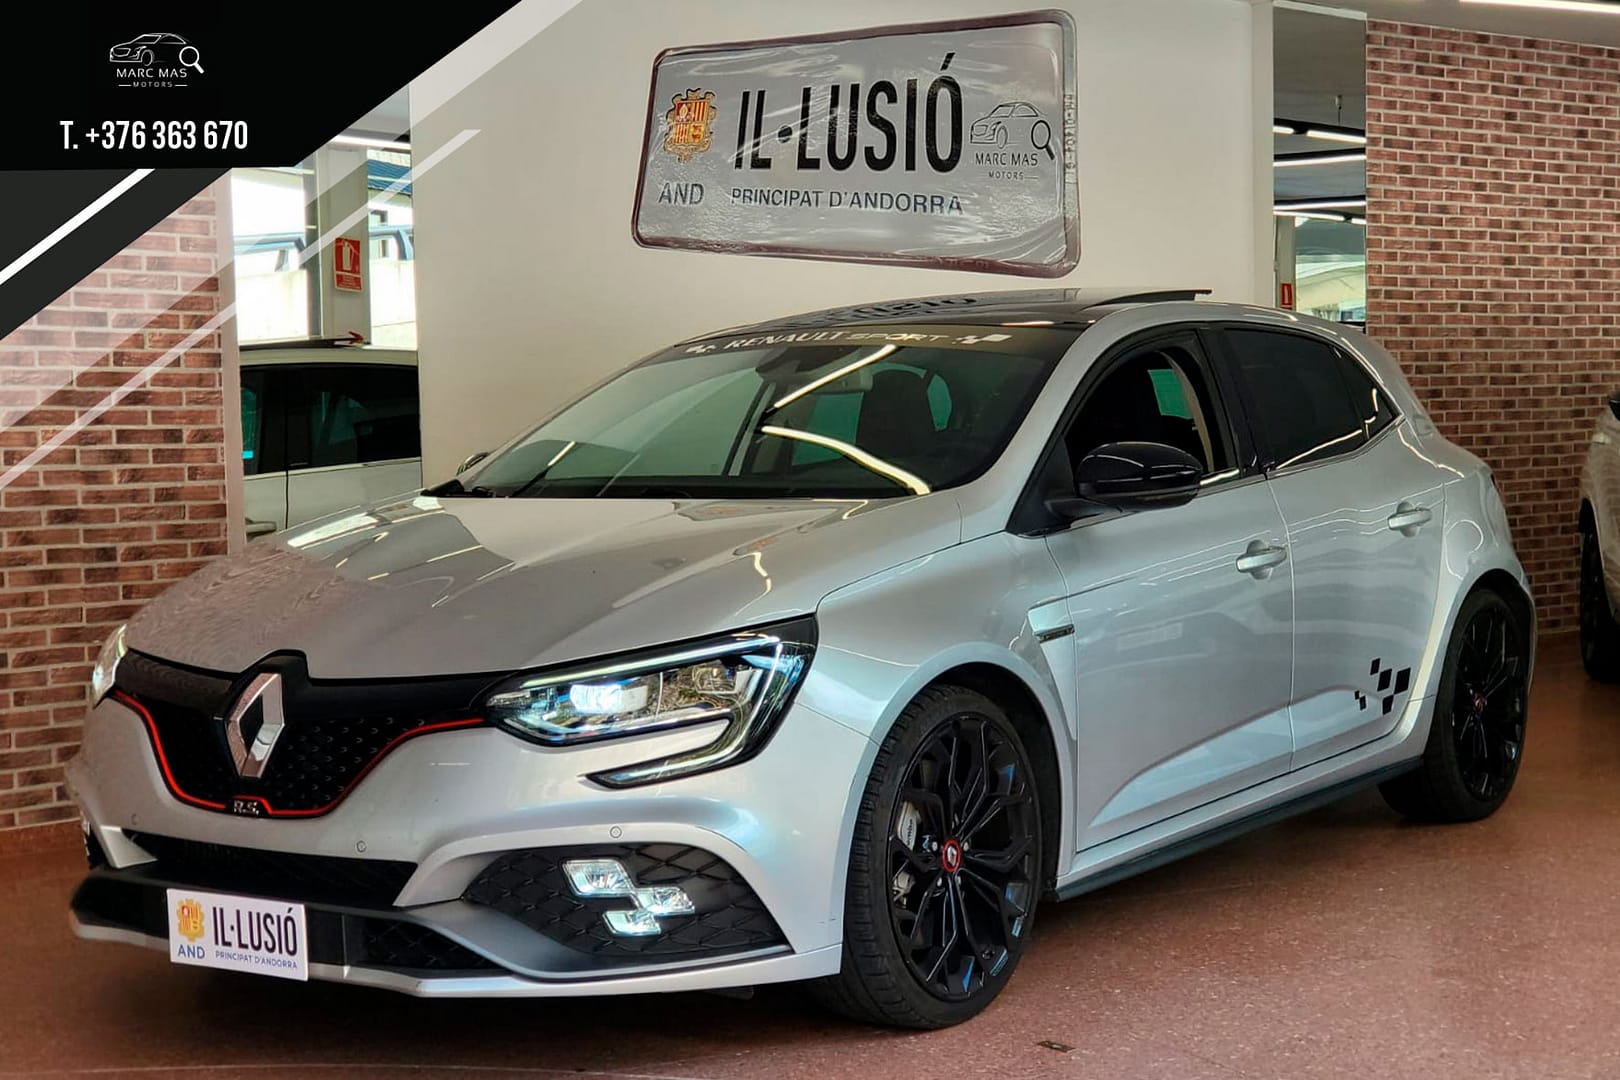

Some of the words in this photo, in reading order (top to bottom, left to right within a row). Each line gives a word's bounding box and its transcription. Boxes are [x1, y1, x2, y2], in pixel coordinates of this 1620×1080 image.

[975, 152, 1007, 166] MARC
[1011, 153, 1039, 167] MAS
[658, 182, 705, 206] AND
[731, 188, 824, 209] PRINCIPAT
[829, 190, 964, 216] D'ANDORRA
[723, 331, 845, 350] RENAULT
[846, 331, 950, 344] SPORT
[177, 944, 206, 960] AND
[215, 950, 253, 962] PRINCIPAT
[254, 956, 298, 969] D'ANDORRA
